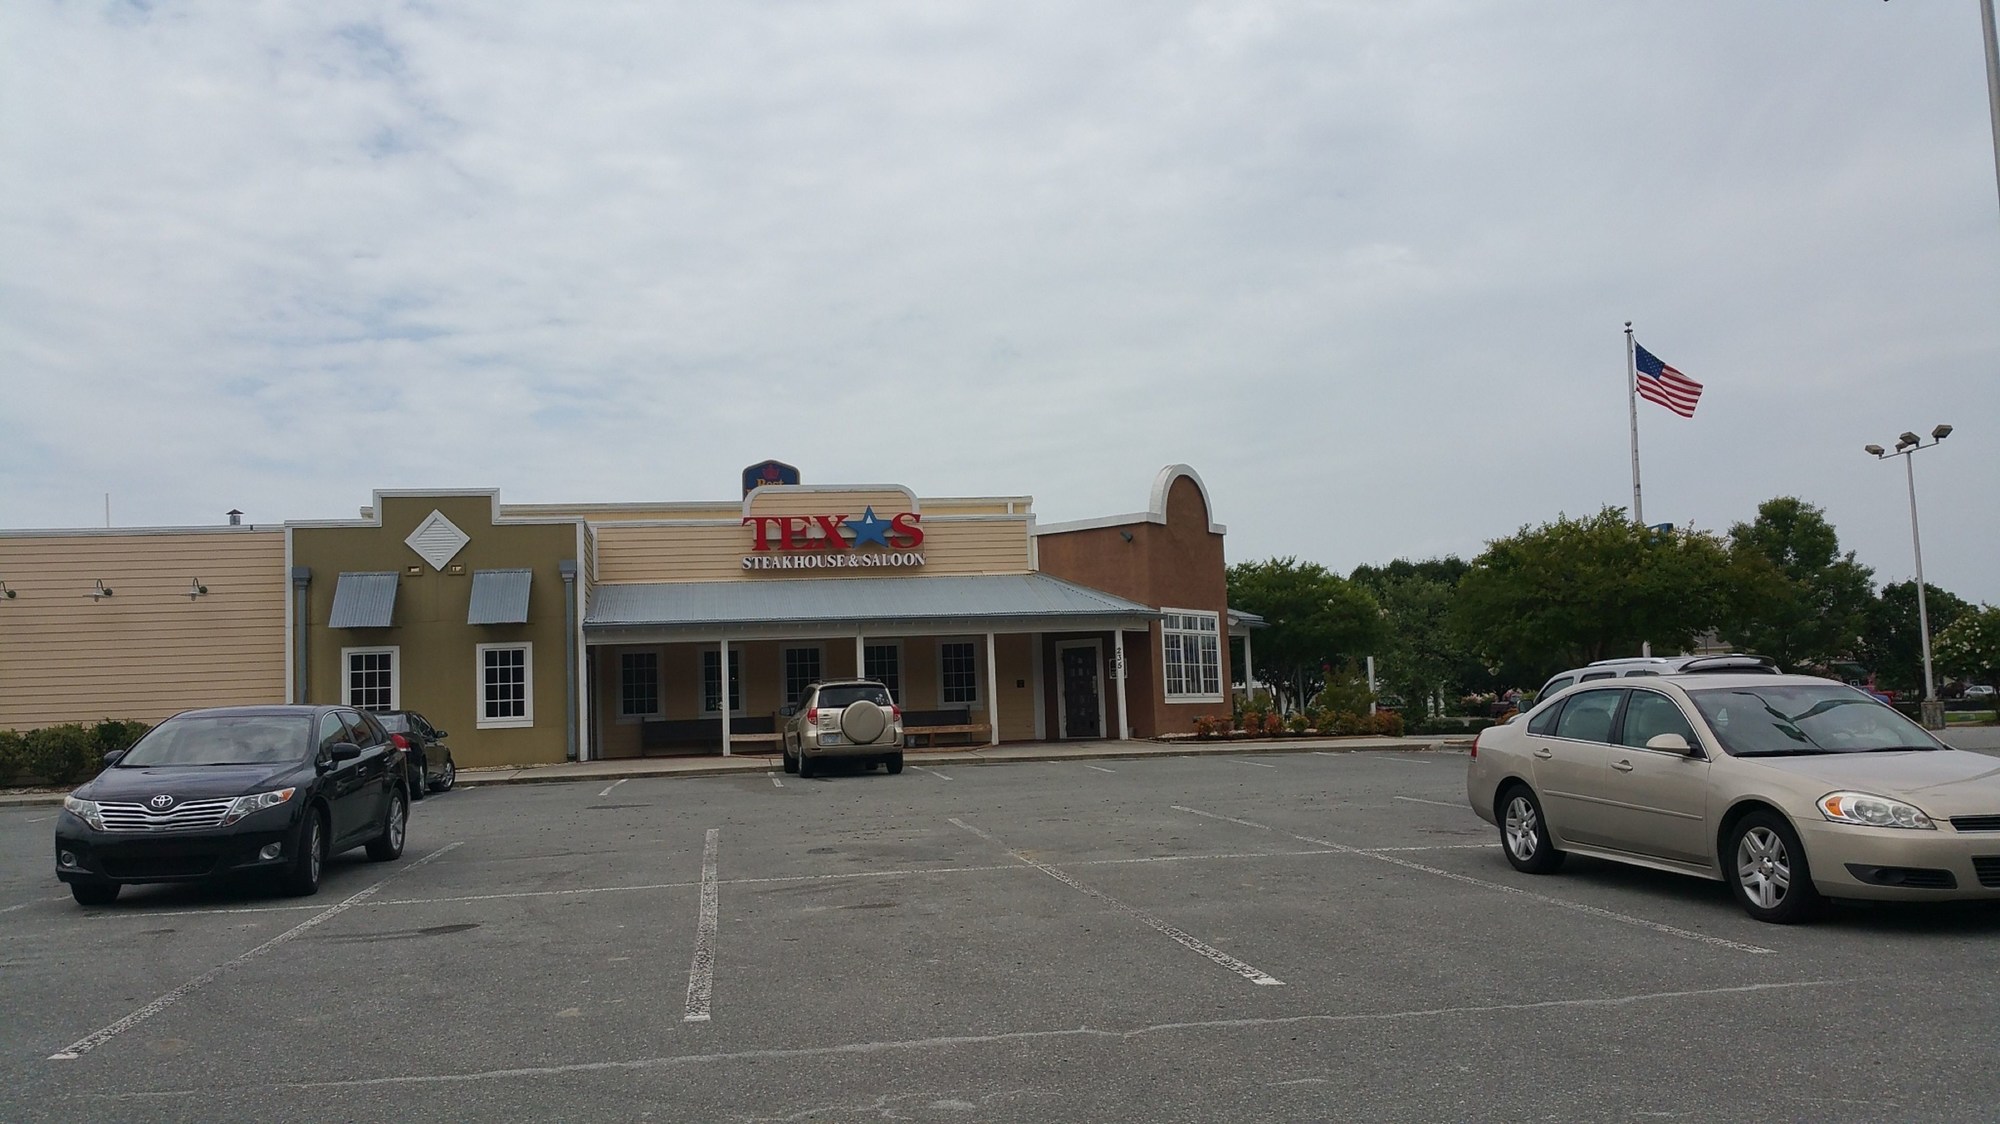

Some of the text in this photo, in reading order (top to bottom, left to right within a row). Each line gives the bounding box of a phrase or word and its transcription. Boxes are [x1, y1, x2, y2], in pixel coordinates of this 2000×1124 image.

[742, 553, 925, 569] STEAKHOUSE & SALOON
